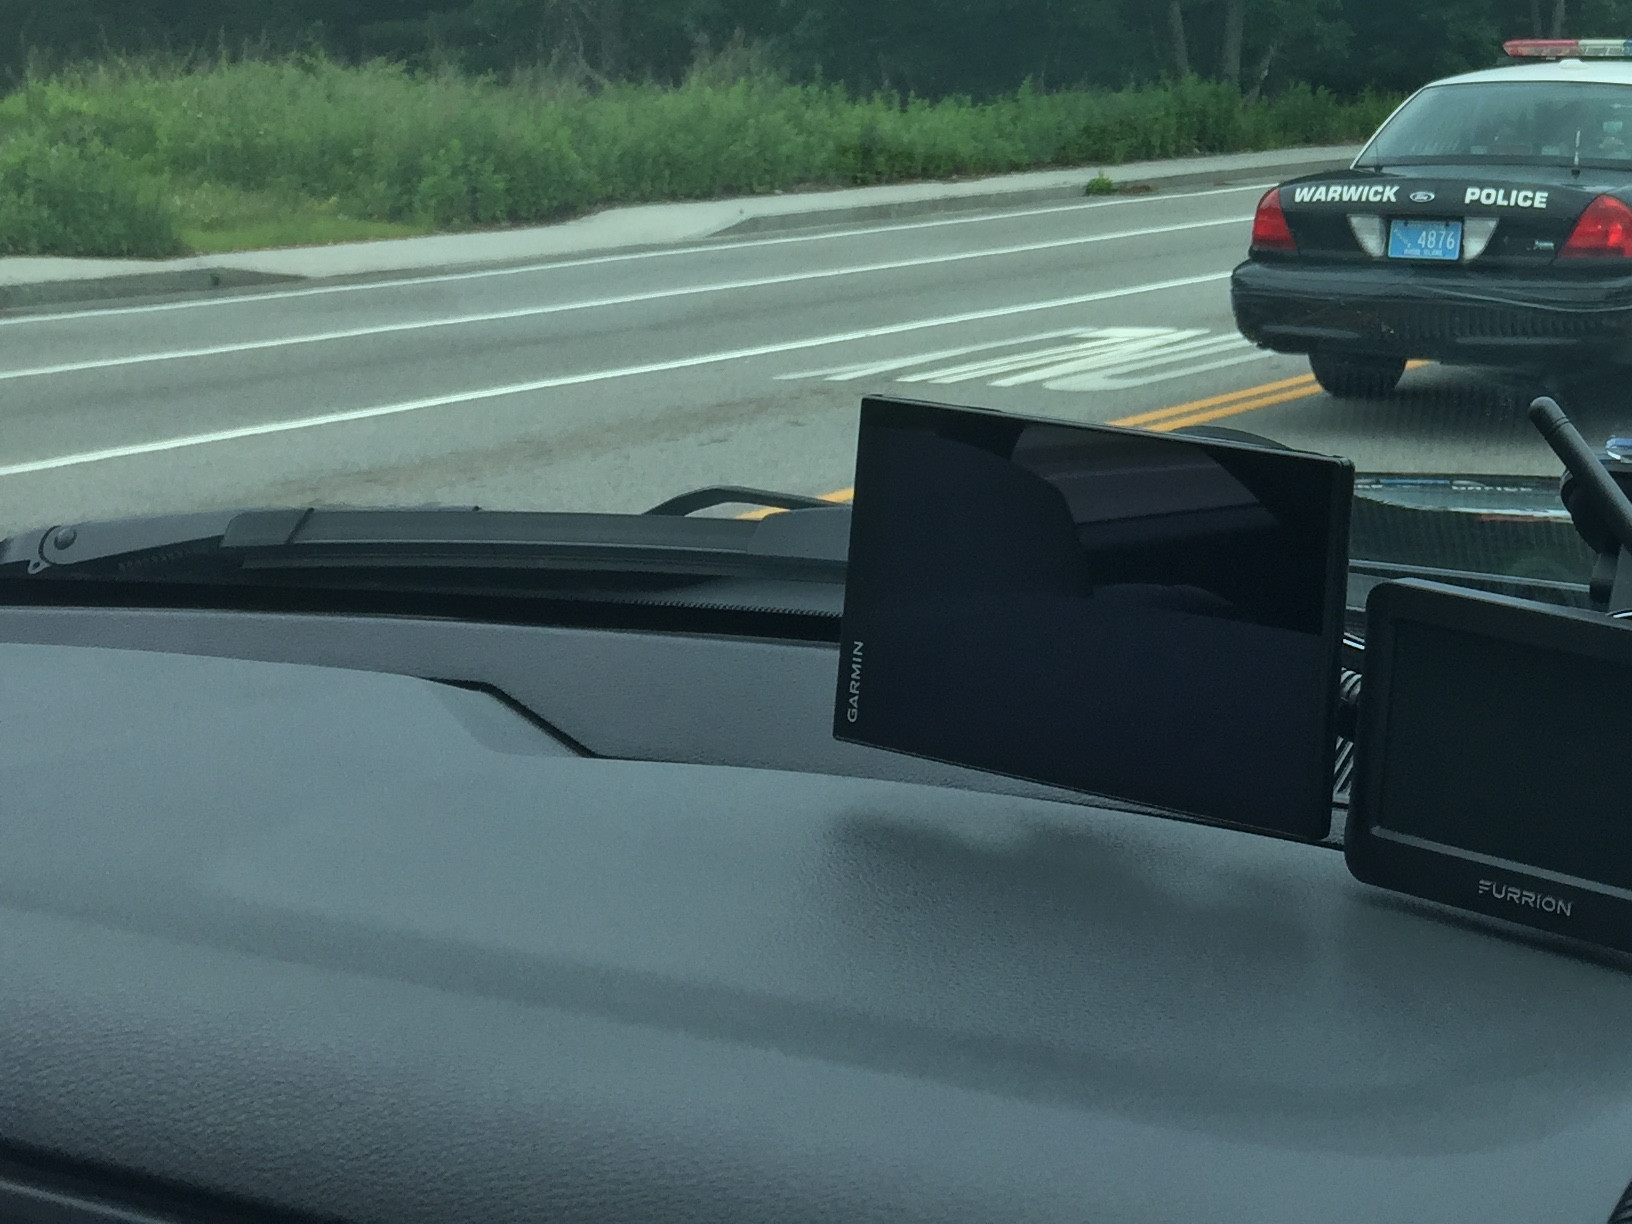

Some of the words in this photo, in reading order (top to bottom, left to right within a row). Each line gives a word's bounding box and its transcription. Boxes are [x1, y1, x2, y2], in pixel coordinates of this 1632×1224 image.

[1294, 185, 1400, 203] WARWICK
[1464, 186, 1549, 209] POLICE
[1417, 230, 1456, 250] 4876
[847, 640, 864, 723] GARMIN
[1478, 879, 1573, 917] FURRION
